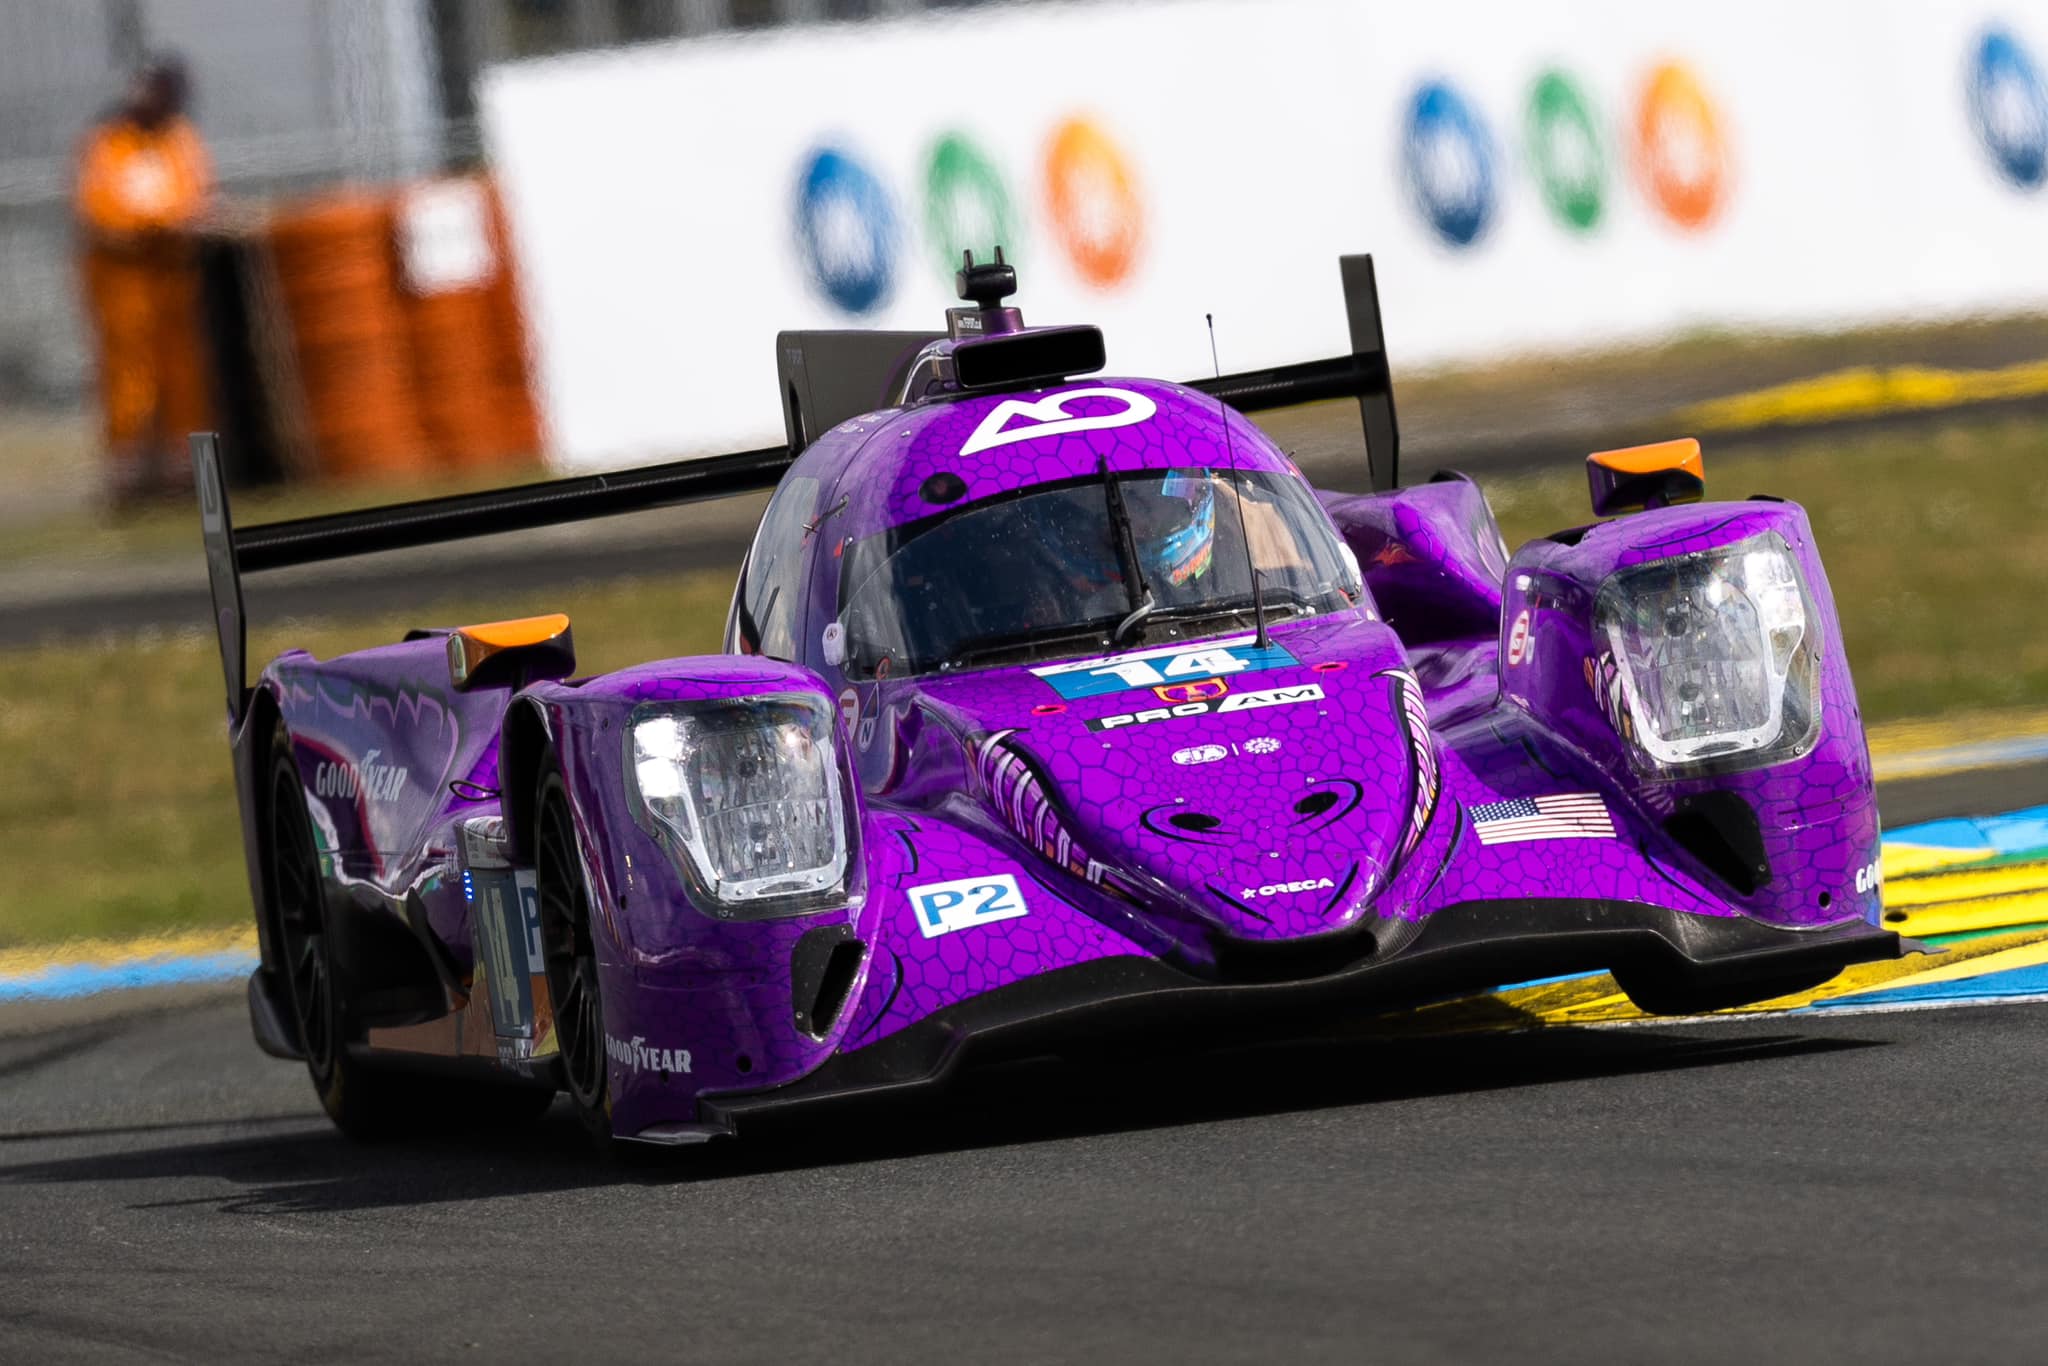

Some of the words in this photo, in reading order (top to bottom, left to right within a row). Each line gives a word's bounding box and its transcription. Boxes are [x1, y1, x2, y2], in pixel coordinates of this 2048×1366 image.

[1090, 648, 1250, 687] 14
[1101, 702, 1209, 729] PRO
[1237, 687, 1317, 707] AM
[919, 884, 1017, 927] P2
[1258, 877, 1335, 896] ORECA
